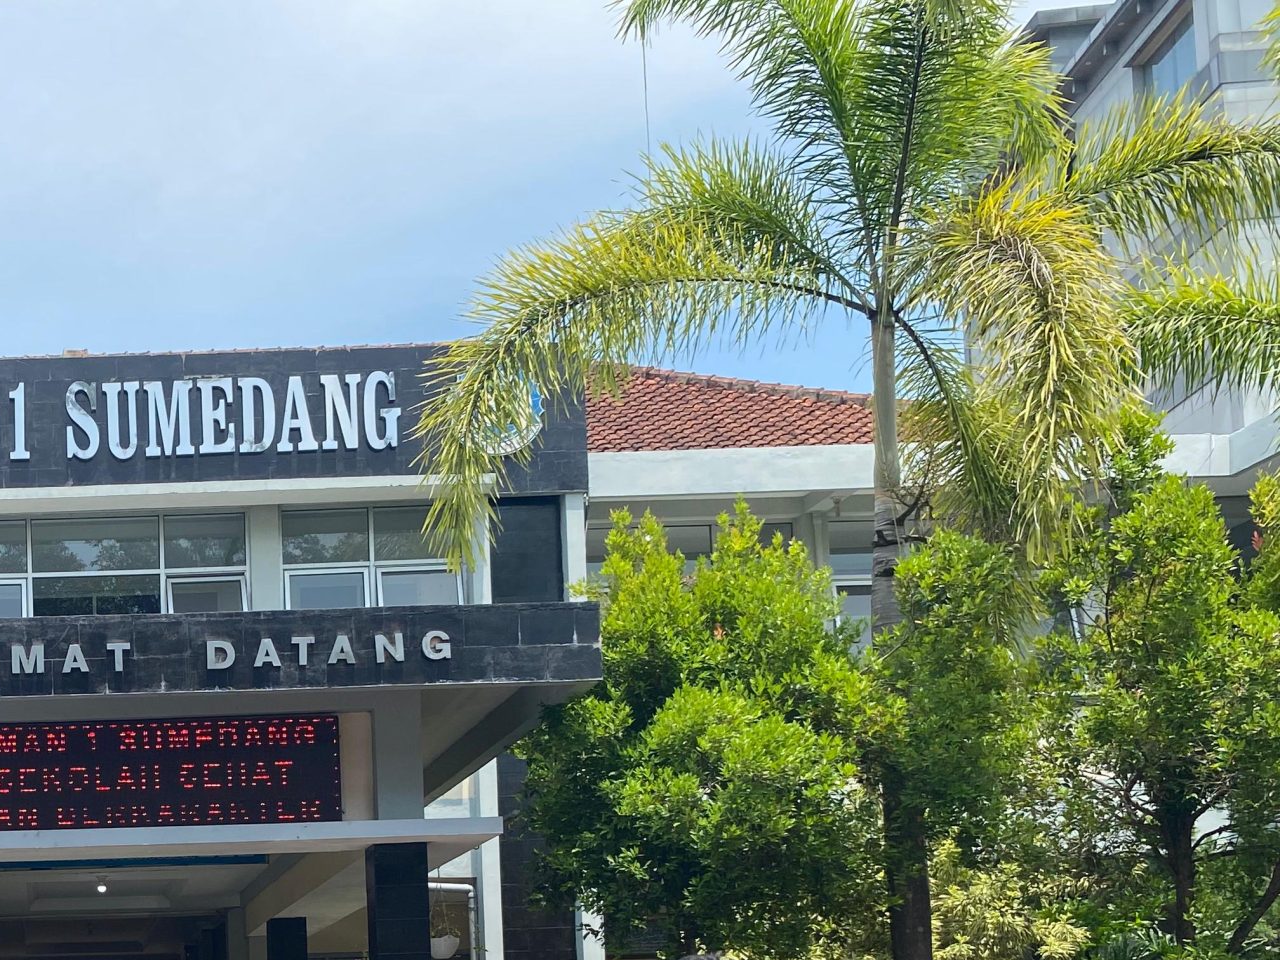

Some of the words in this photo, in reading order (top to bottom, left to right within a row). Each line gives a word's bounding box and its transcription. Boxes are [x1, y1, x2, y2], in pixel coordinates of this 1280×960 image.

[8, 382, 30, 460] 1
[65, 371, 402, 461] SUMEDANG
[206, 630, 452, 670] DATANG
